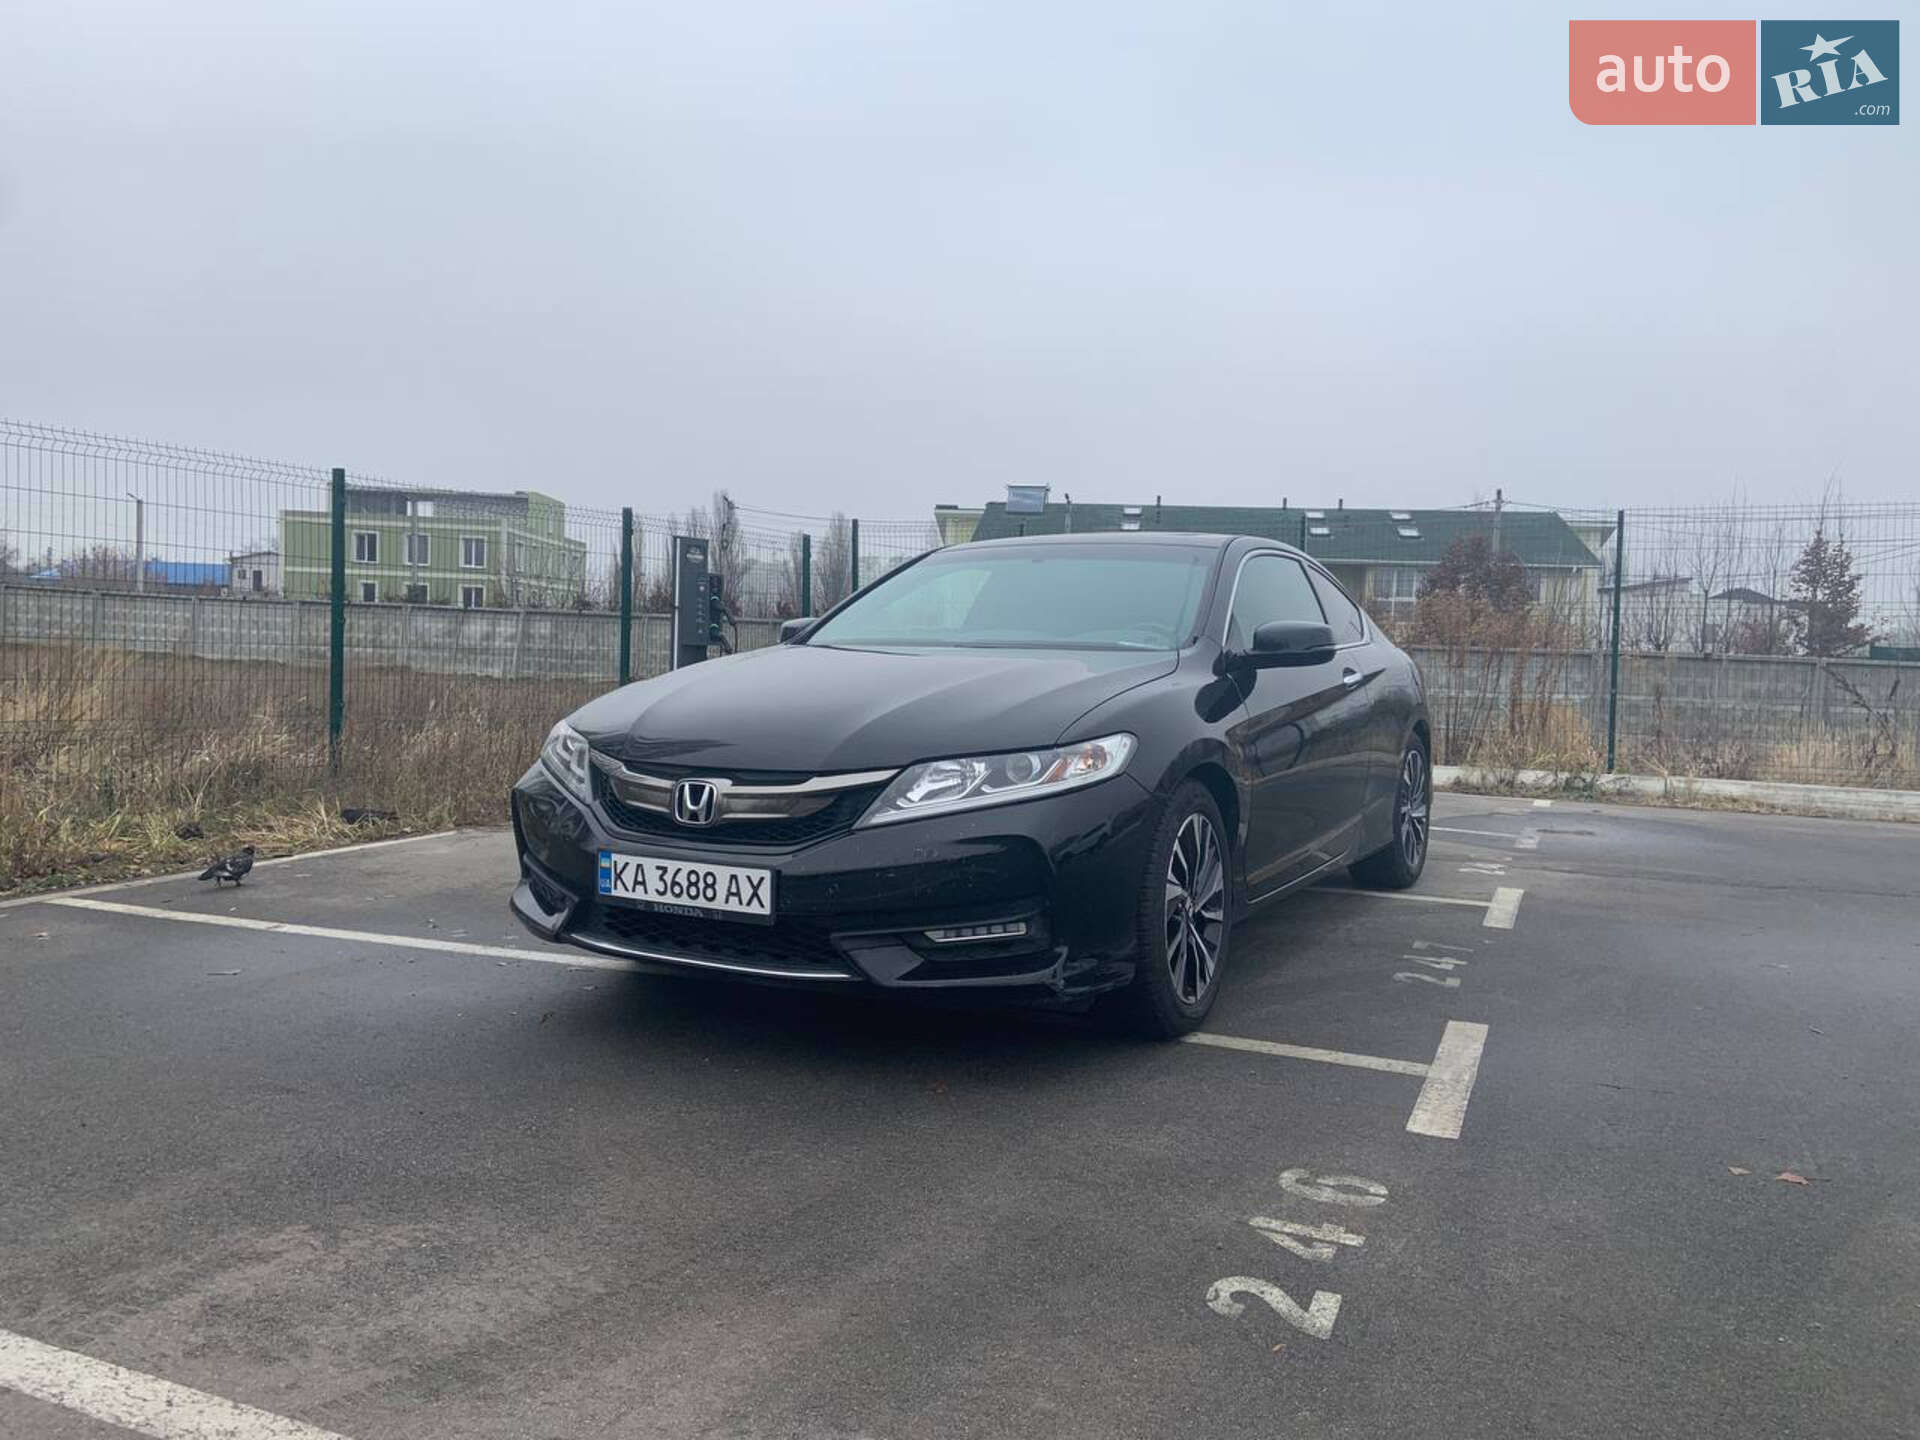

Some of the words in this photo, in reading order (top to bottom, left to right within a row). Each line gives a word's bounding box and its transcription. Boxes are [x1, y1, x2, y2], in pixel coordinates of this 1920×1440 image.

[613, 860, 648, 894] KA
[655, 865, 717, 902] 3688
[725, 874, 765, 908] AX
[1206, 1168, 1389, 1340] 246
